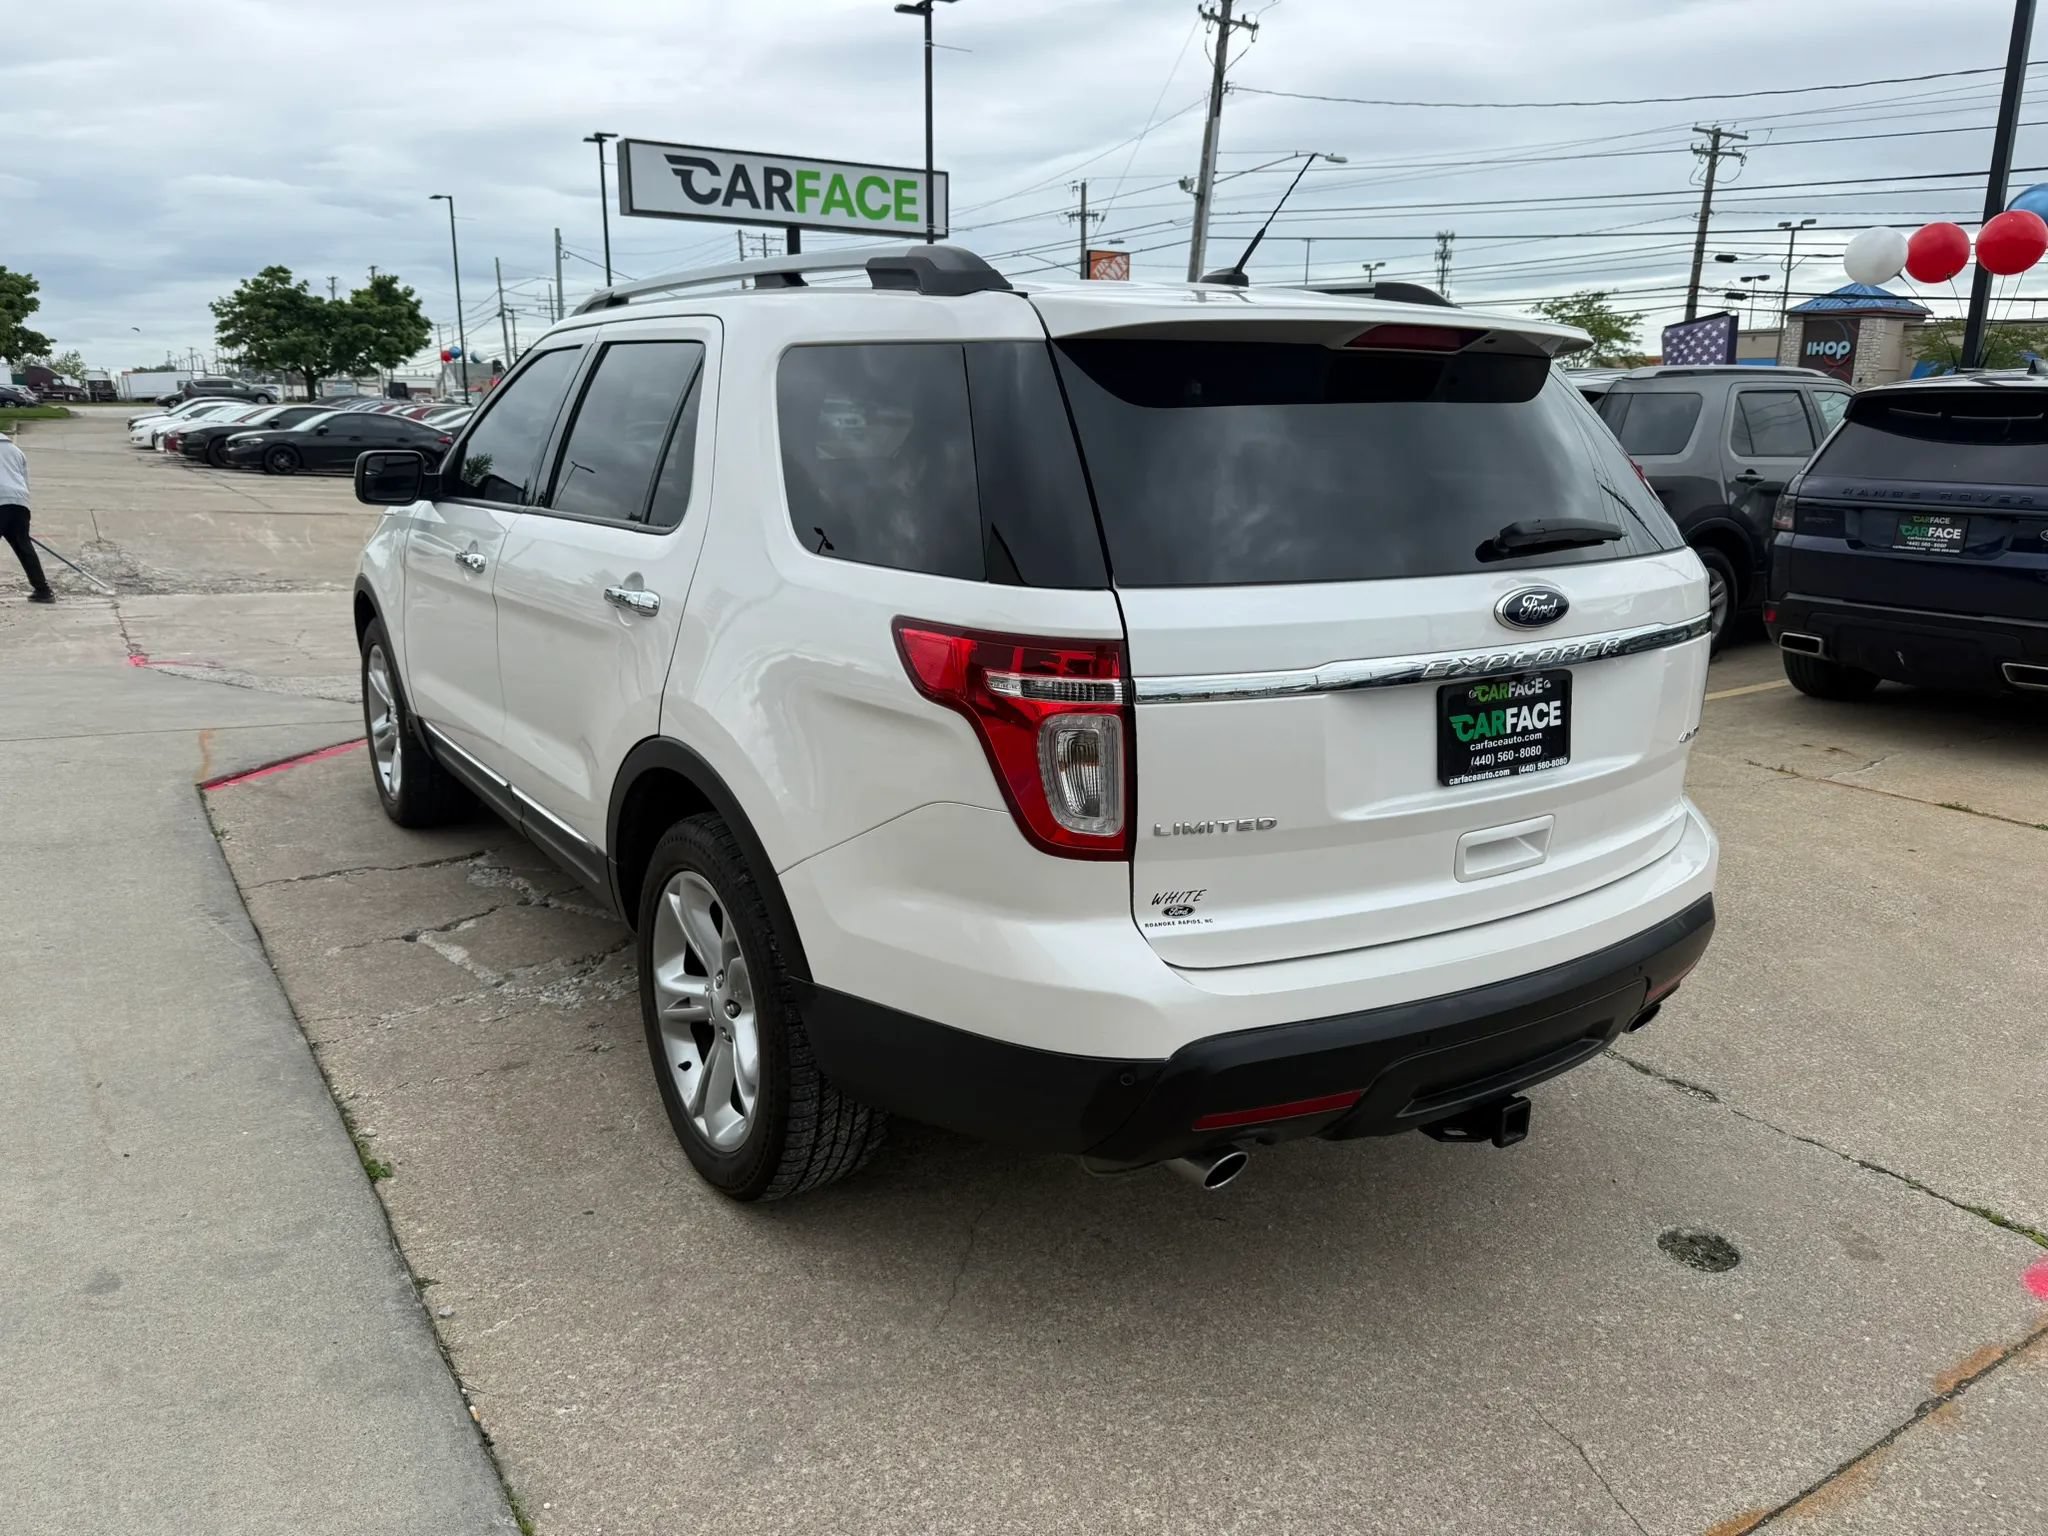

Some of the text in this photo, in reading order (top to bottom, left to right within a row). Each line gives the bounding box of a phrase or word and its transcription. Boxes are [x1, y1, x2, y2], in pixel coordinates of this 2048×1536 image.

[663, 153, 919, 223] CARFACE
[1912, 515, 1951, 524] CARFACE
[1900, 524, 1962, 539] CARFACE
[1519, 594, 1558, 621] Ford
[1421, 637, 1621, 679] EXPLORER
[1475, 678, 1544, 702] CARFACE
[1449, 700, 1562, 742] CARFACE
[1470, 732, 1542, 751] carfaceauto.com
[1470, 753, 1495, 767] (440)
[1448, 769, 1510, 786] carfaceauto.com
[1518, 764, 1537, 775] (440)
[1153, 816, 1277, 837] LIMITED
[1151, 888, 1207, 906] WHITE
